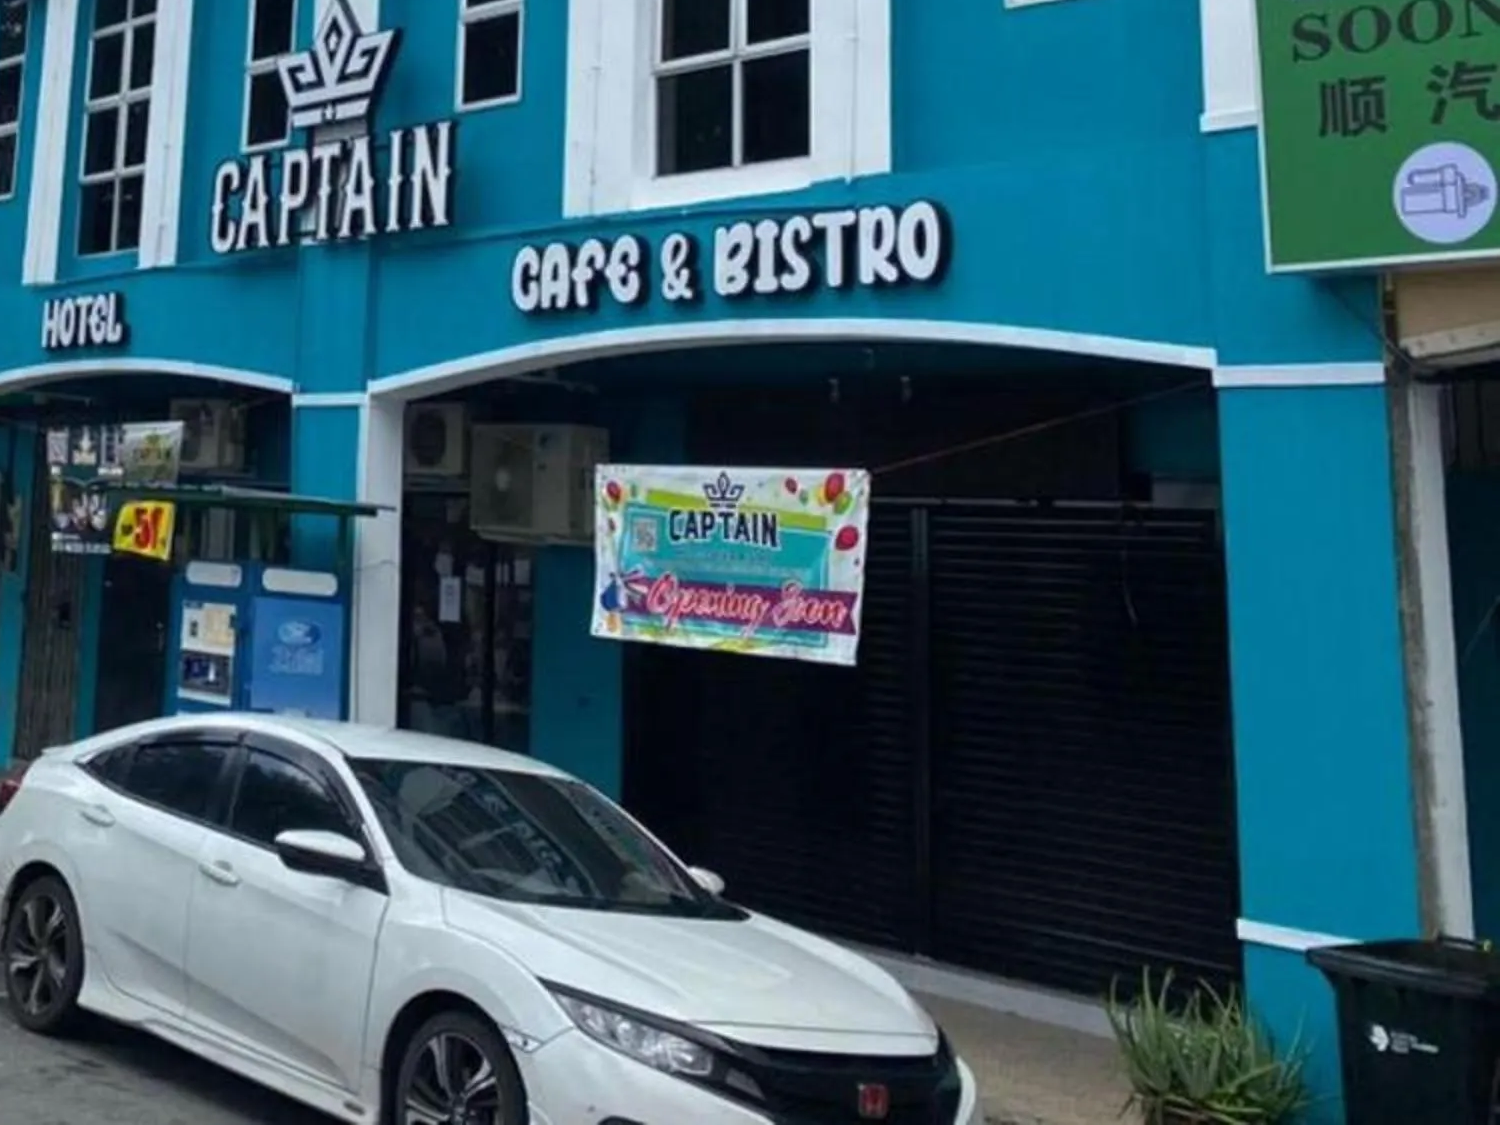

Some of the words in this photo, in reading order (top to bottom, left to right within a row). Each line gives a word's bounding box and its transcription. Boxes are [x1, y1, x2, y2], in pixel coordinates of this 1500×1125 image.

[210, 121, 458, 255] CAPTAIN
[512, 240, 642, 313] CAFE
[660, 234, 694, 302] &
[714, 202, 944, 297] BISTRO
[40, 295, 124, 349] HOTEL
[668, 509, 779, 548] CAPTAIN
[647, 571, 770, 638] Opening
